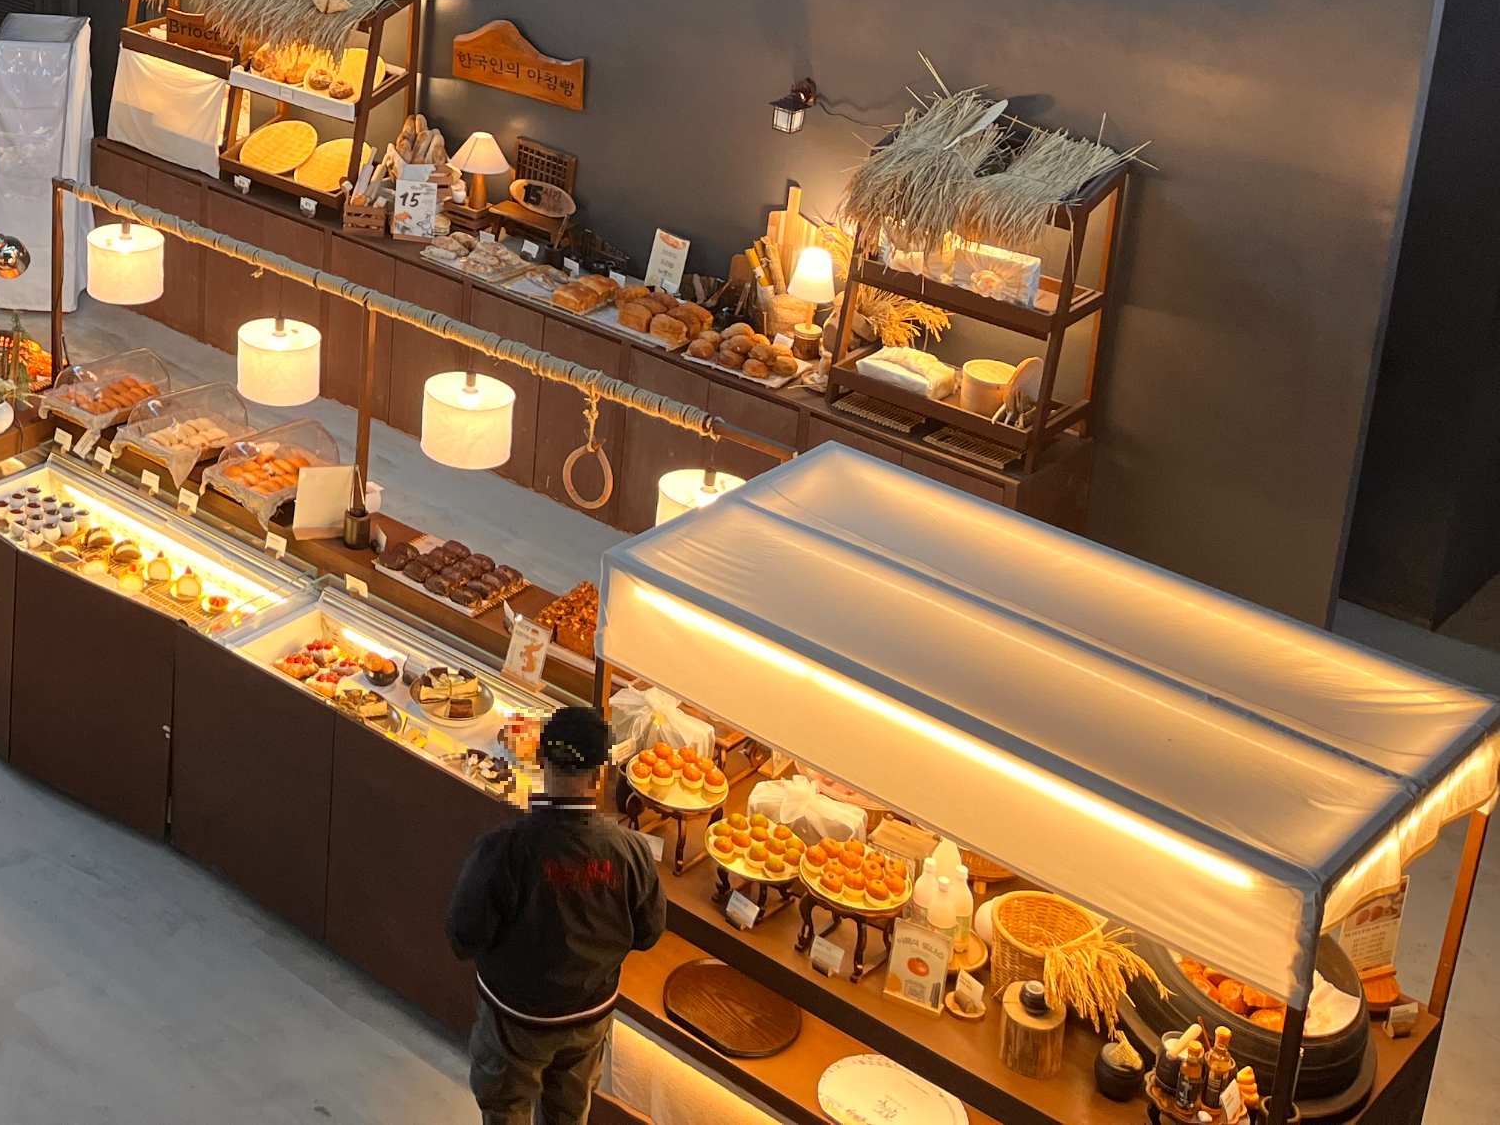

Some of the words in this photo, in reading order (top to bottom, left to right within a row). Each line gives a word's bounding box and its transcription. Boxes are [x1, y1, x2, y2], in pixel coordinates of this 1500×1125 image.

[457, 51, 520, 79] 한국인의
[527, 69, 576, 98] 아침빵
[399, 191, 421, 208] 15
[523, 183, 543, 206] 15
